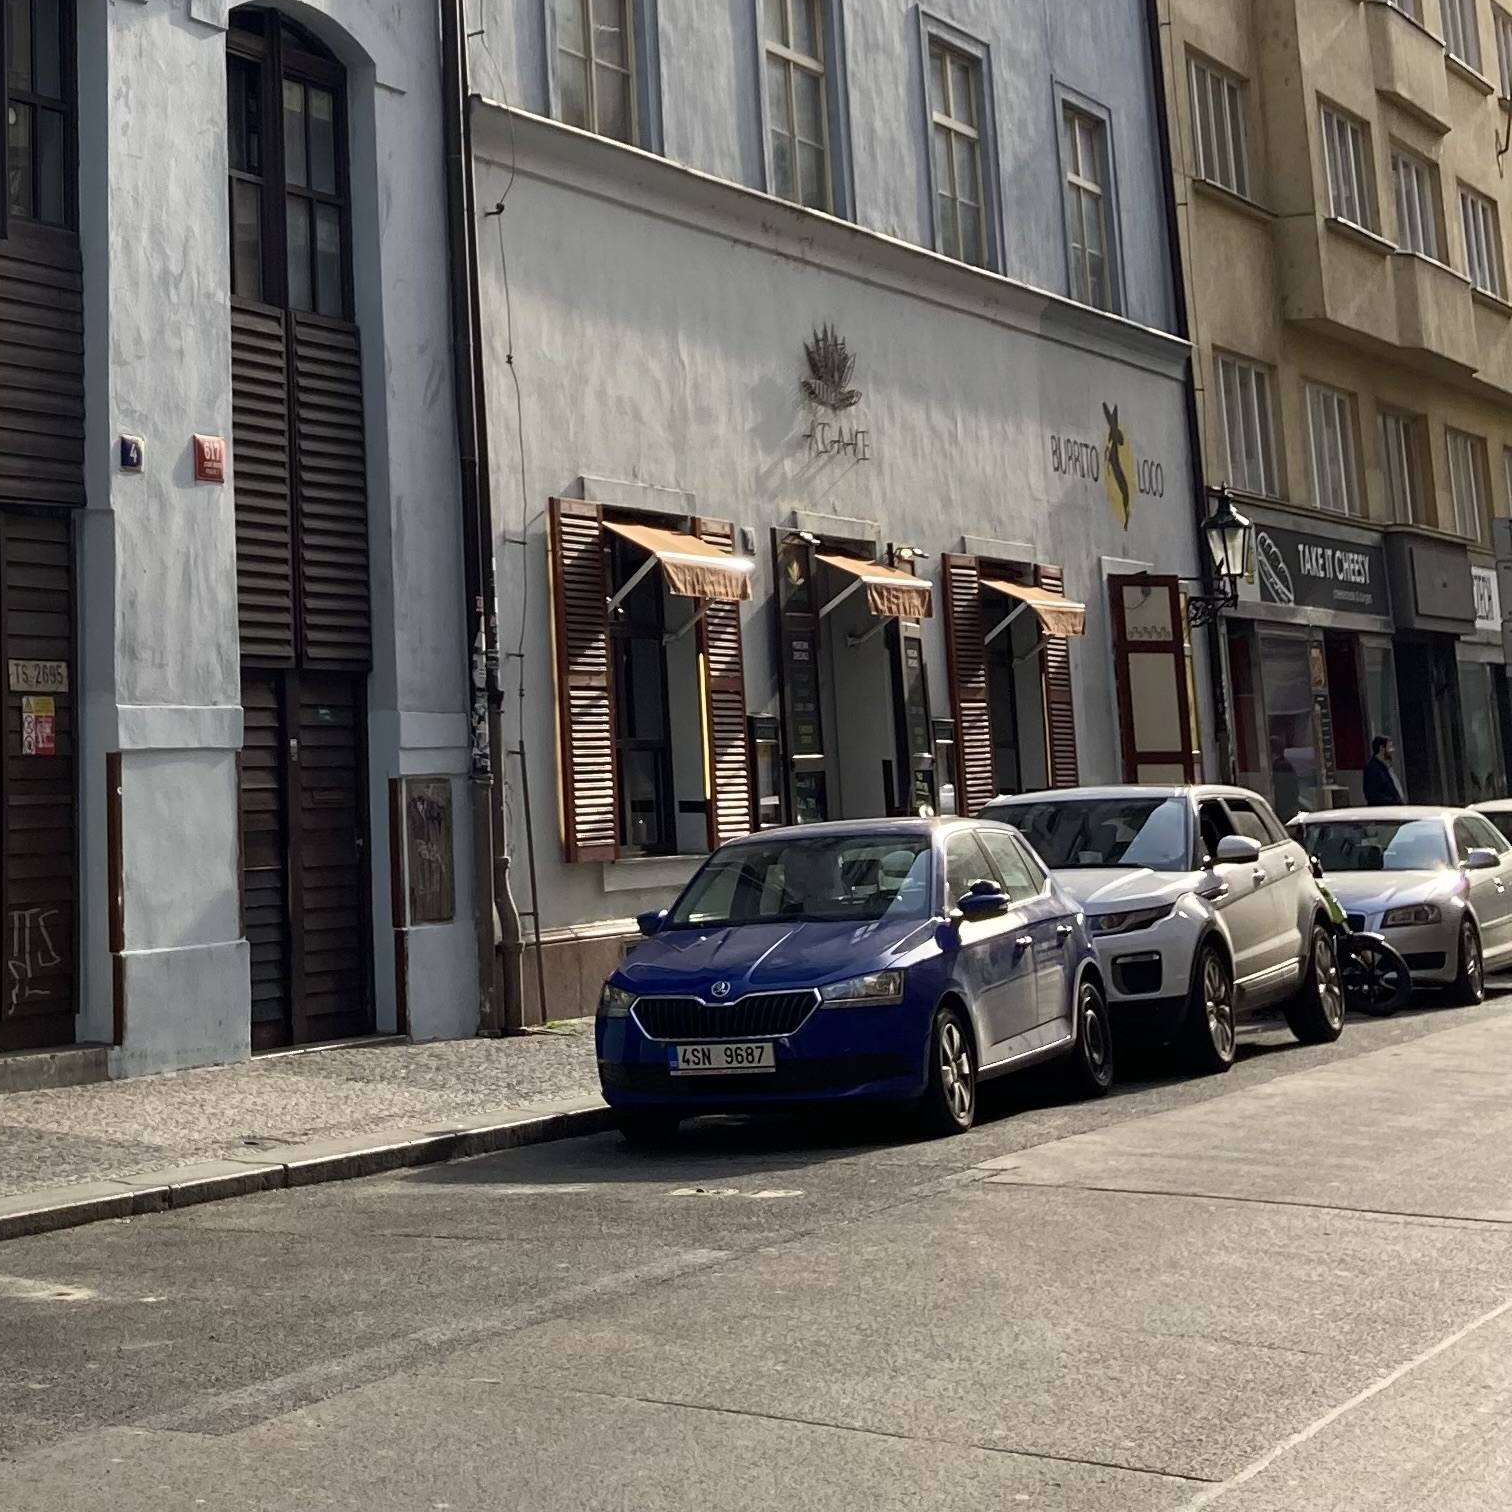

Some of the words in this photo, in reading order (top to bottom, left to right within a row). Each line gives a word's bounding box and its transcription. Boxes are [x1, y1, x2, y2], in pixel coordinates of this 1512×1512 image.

[129, 443, 138, 463] 4
[203, 441, 221, 461] 617
[1050, 434, 1100, 483] BURRITO
[1137, 459, 1164, 498] LOCO
[1298, 543, 1325, 578] TAKE
[1324, 548, 1334, 580] IT
[1334, 549, 1370, 585] CHEESY
[13, 663, 30, 685] TS
[35, 664, 64, 685] 2695
[682, 1048, 712, 1066] 4SN
[723, 1045, 765, 1065] 9687
